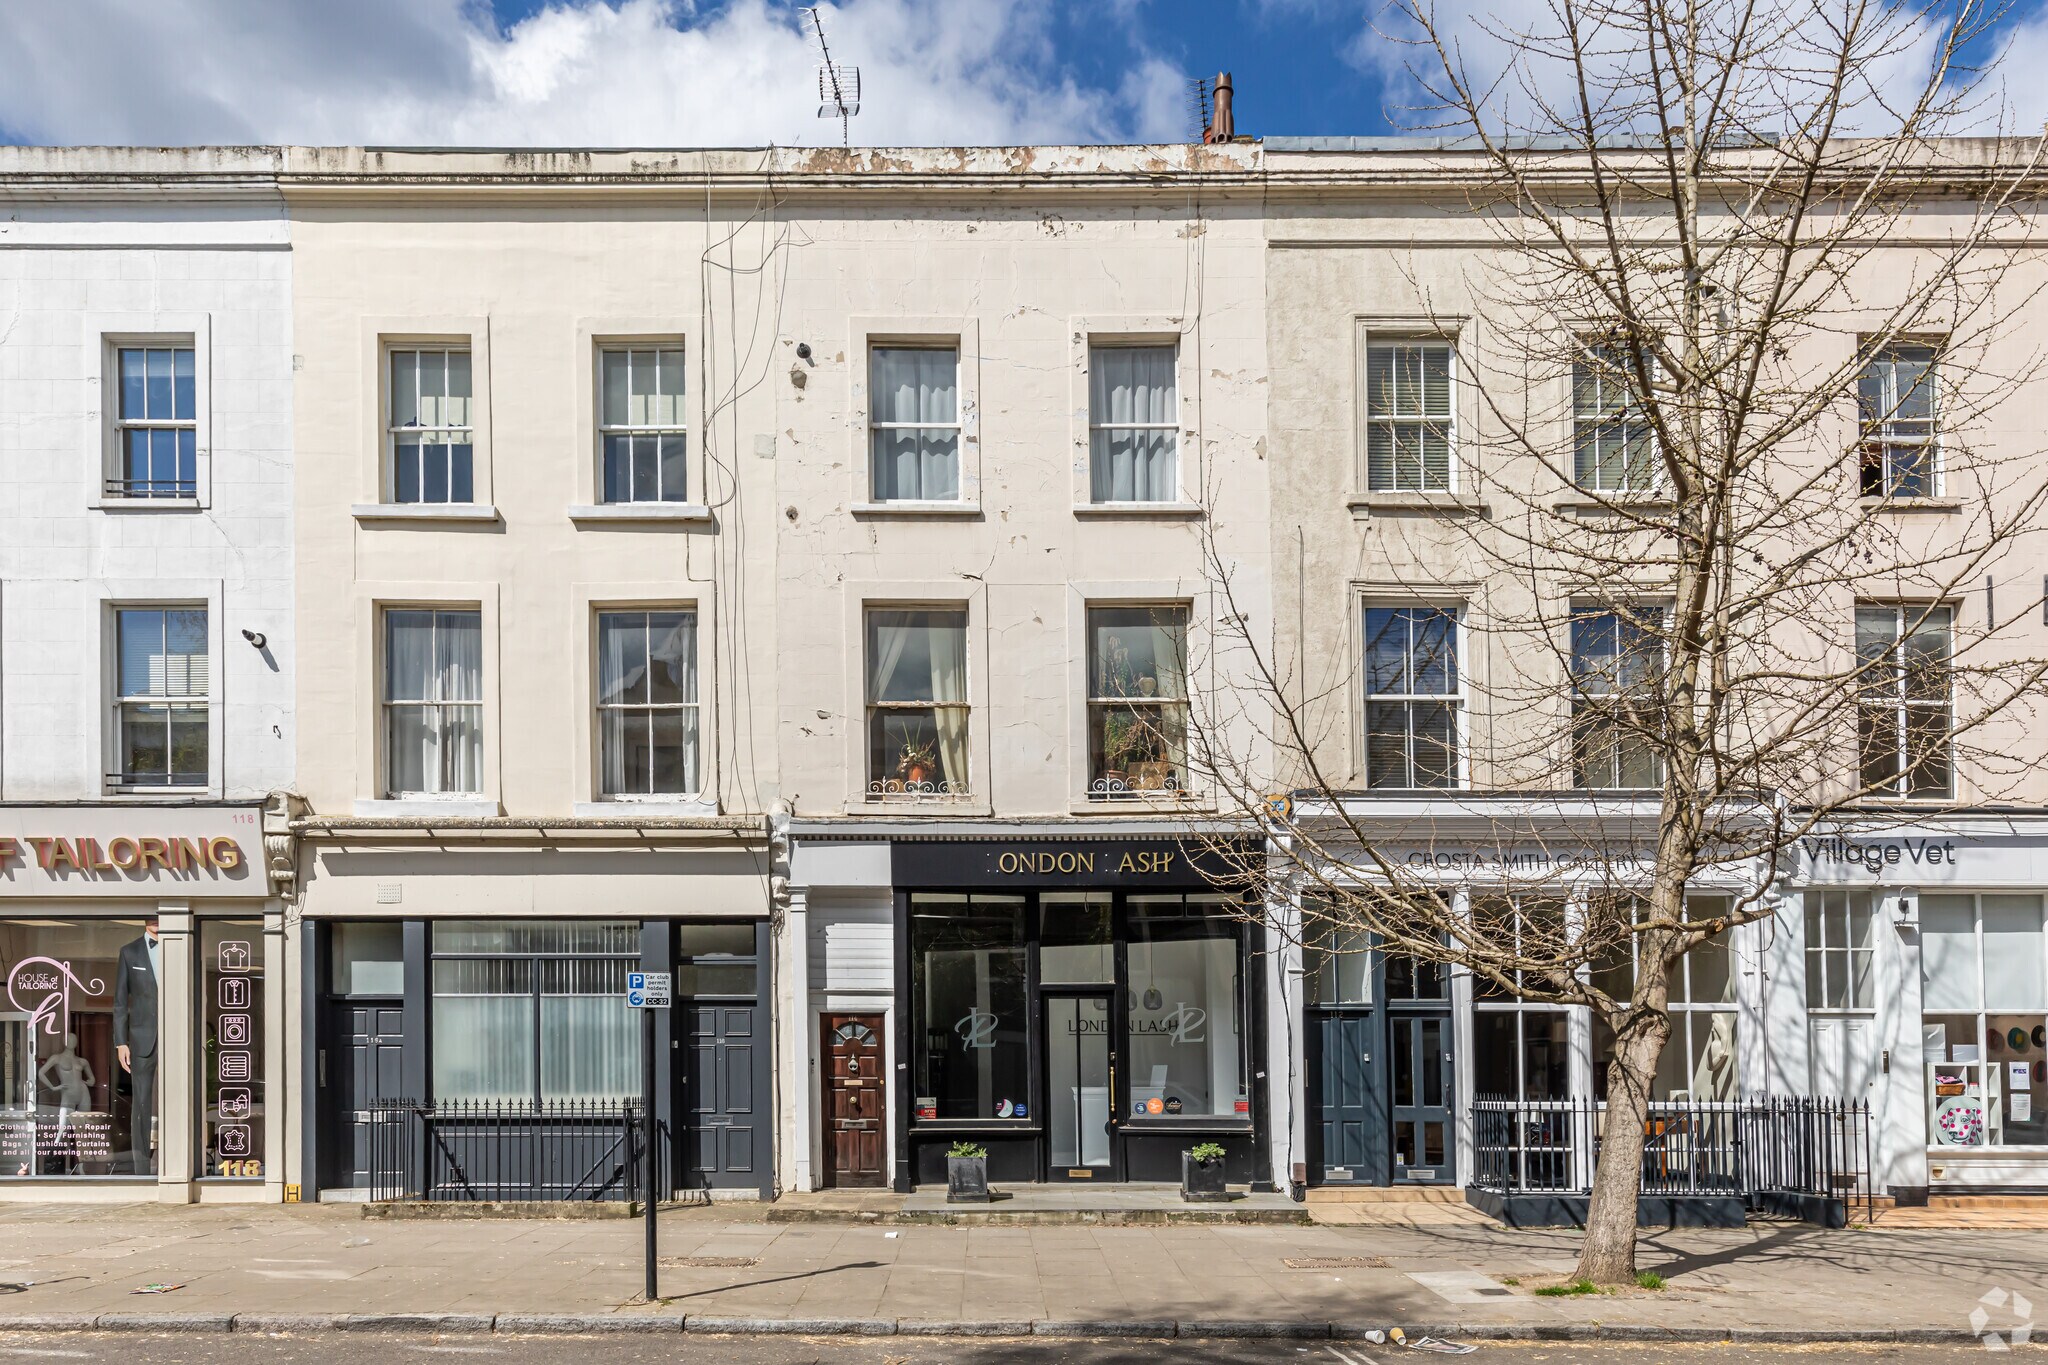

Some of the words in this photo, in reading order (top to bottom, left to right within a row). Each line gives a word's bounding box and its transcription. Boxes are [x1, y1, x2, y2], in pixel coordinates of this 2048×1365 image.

[232, 814, 254, 824] 118
[24, 836, 241, 869] TAILORING
[1800, 837, 1901, 874] Village
[1904, 838, 1956, 865] Vet
[1408, 852, 1485, 871] CROSTA
[1492, 853, 1550, 871] SMITH
[18, 973, 49, 983] HOUSE
[50, 975, 59, 983] of
[18, 982, 58, 990] TAILORING
[53, 1149, 81, 1157] sewing
[218, 1160, 261, 1177] 118
[286, 1185, 299, 1202] H
